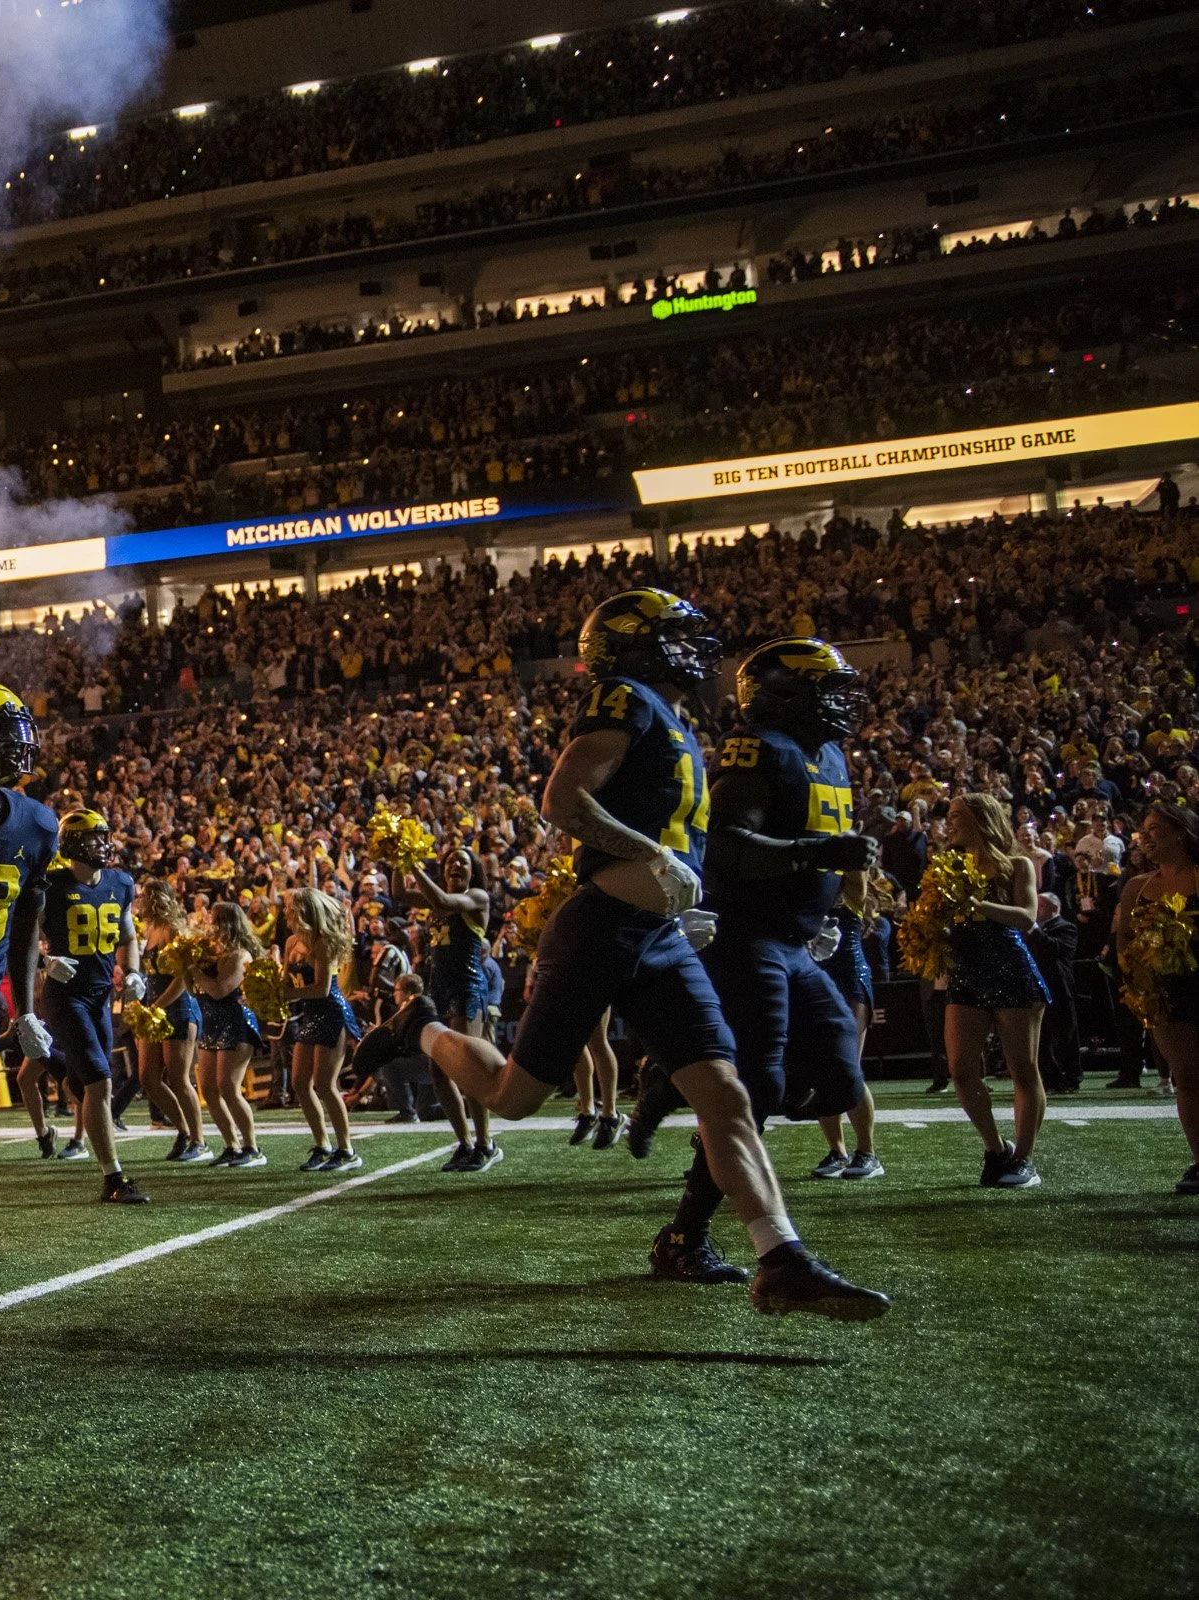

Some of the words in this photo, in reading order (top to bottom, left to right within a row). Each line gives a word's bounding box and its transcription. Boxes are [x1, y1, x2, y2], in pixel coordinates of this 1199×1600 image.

[673, 290, 757, 314] Huntington
[713, 470, 742, 486] BIG
[746, 465, 779, 483] TEN
[784, 455, 871, 478] FOOTBALL
[876, 437, 1016, 467] CHAMPIONSHIP
[1021, 429, 1076, 448] GAME
[226, 515, 341, 547] MICHIGAN
[347, 497, 501, 532] WOLVERINES
[586, 683, 632, 720] 14
[720, 738, 760, 768] 55
[66, 902, 121, 955] 86
[670, 1233, 685, 1245] M
